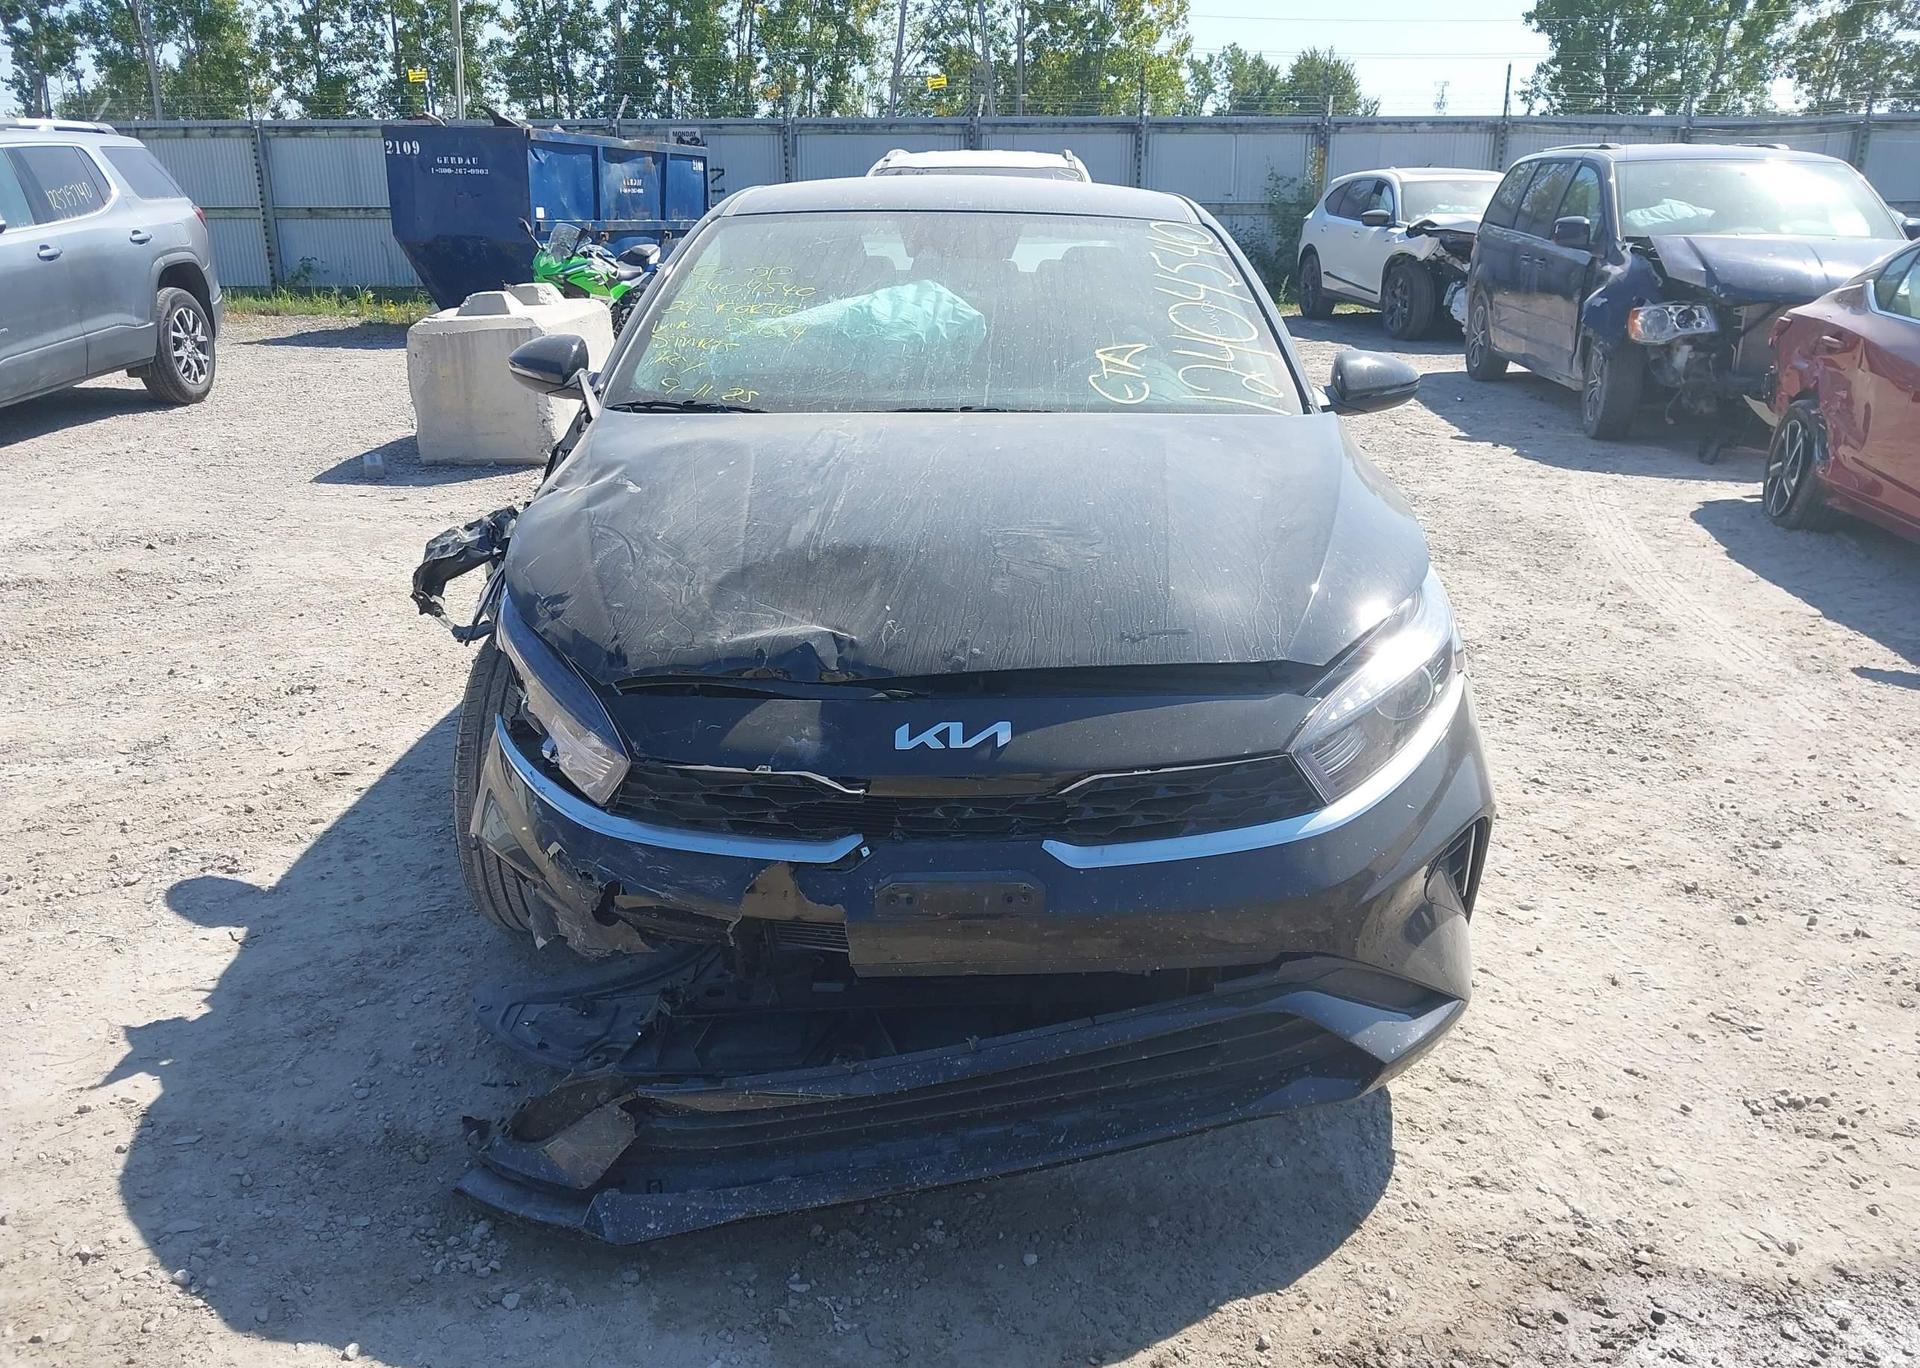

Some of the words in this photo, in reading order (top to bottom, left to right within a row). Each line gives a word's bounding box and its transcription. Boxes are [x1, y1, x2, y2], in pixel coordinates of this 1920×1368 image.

[672, 130, 697, 138] MONDAY
[385, 140, 420, 155] 2109
[436, 156, 479, 165] GERDAU
[1146, 221, 1293, 416] 12404540
[895, 721, 1012, 750] KIA
